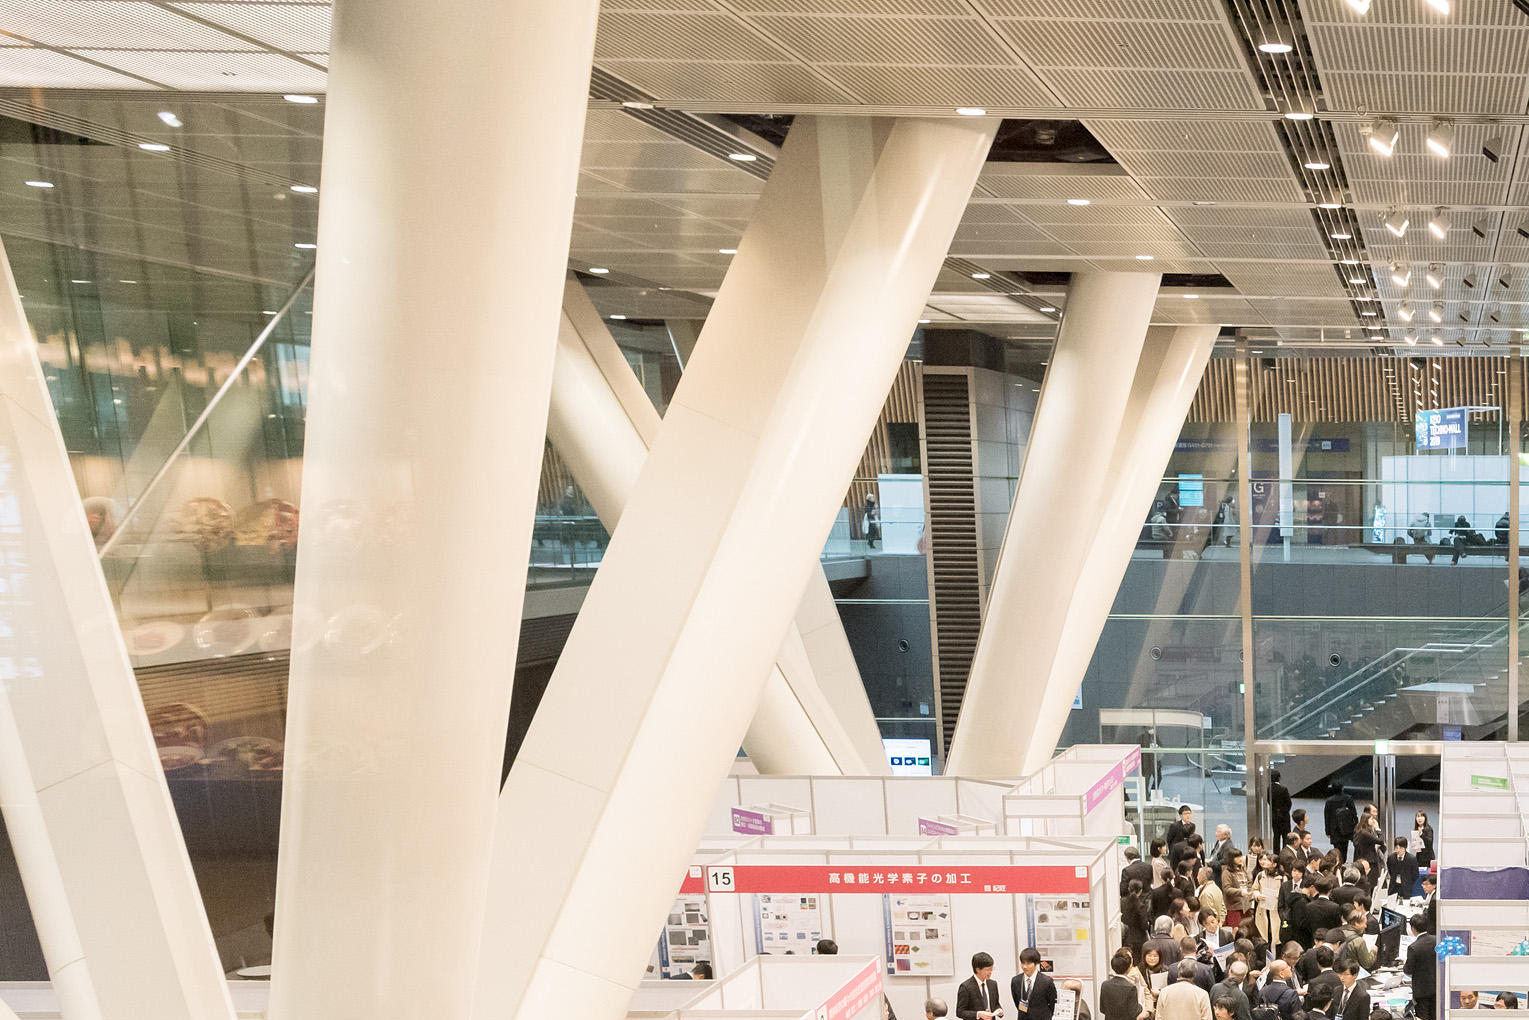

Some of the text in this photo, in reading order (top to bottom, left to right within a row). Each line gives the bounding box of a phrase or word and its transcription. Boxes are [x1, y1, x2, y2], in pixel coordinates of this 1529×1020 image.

[711, 872, 732, 887] 15
[828, 871, 973, 885] 高機能光学素子の加工
